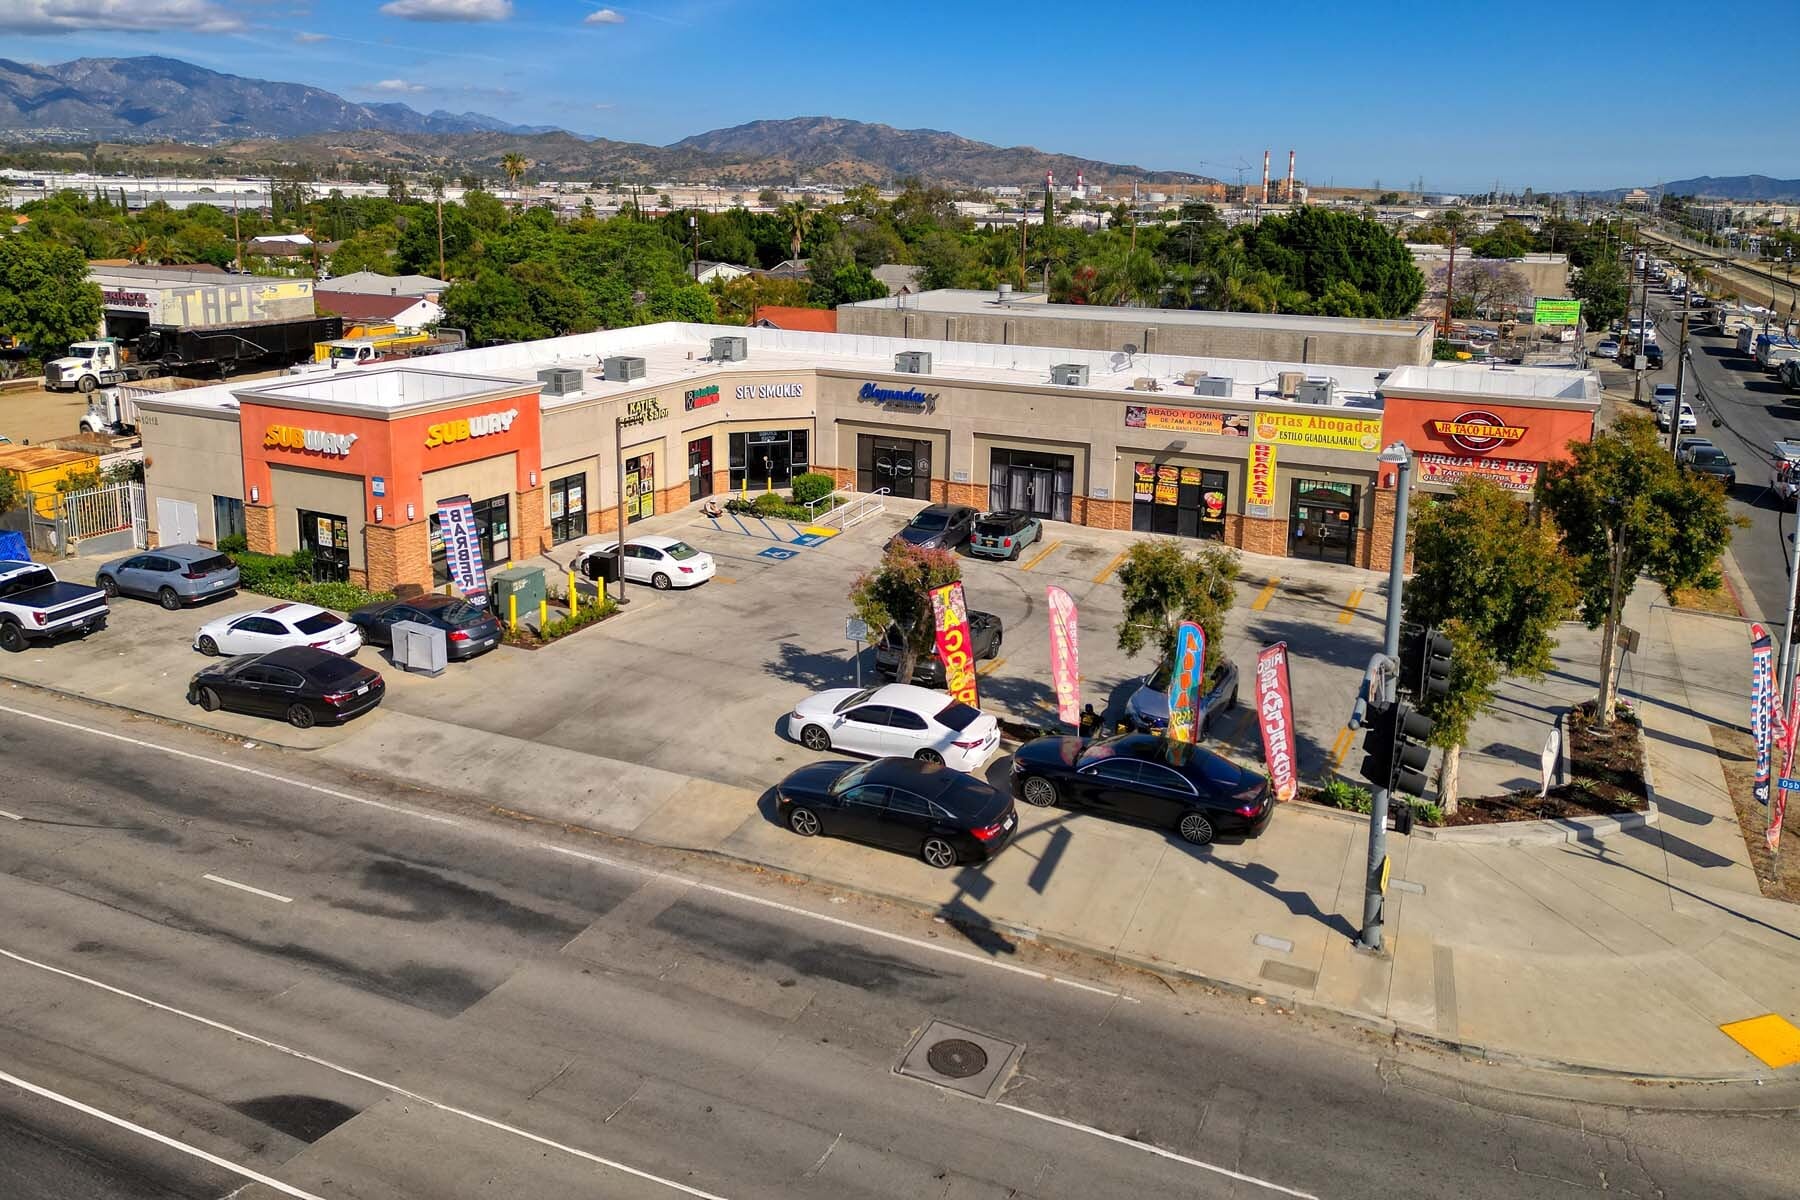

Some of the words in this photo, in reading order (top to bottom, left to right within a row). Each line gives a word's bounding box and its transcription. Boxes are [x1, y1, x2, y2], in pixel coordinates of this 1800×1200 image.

[736, 385, 757, 399] SFV
[759, 384, 803, 399] SMOKES
[649, 408, 669, 420] Salon
[1146, 408, 1178, 417] ABADO
[1189, 412, 1224, 420] DOMING
[1257, 411, 1303, 427] Tortas
[1308, 417, 1380, 433] Ahogadas
[425, 408, 519, 449] SUBWAY
[1280, 431, 1302, 441] ESTILO
[1439, 423, 1451, 432] JR
[1455, 425, 1480, 436] TACO
[1483, 427, 1519, 439] LLAMA
[264, 424, 358, 456] SUBWAY
[1253, 444, 1270, 498] BREAKFAST
[1421, 453, 1473, 467] BIRRIA
[1480, 458, 1501, 471] DE
[1505, 461, 1537, 473] RES
